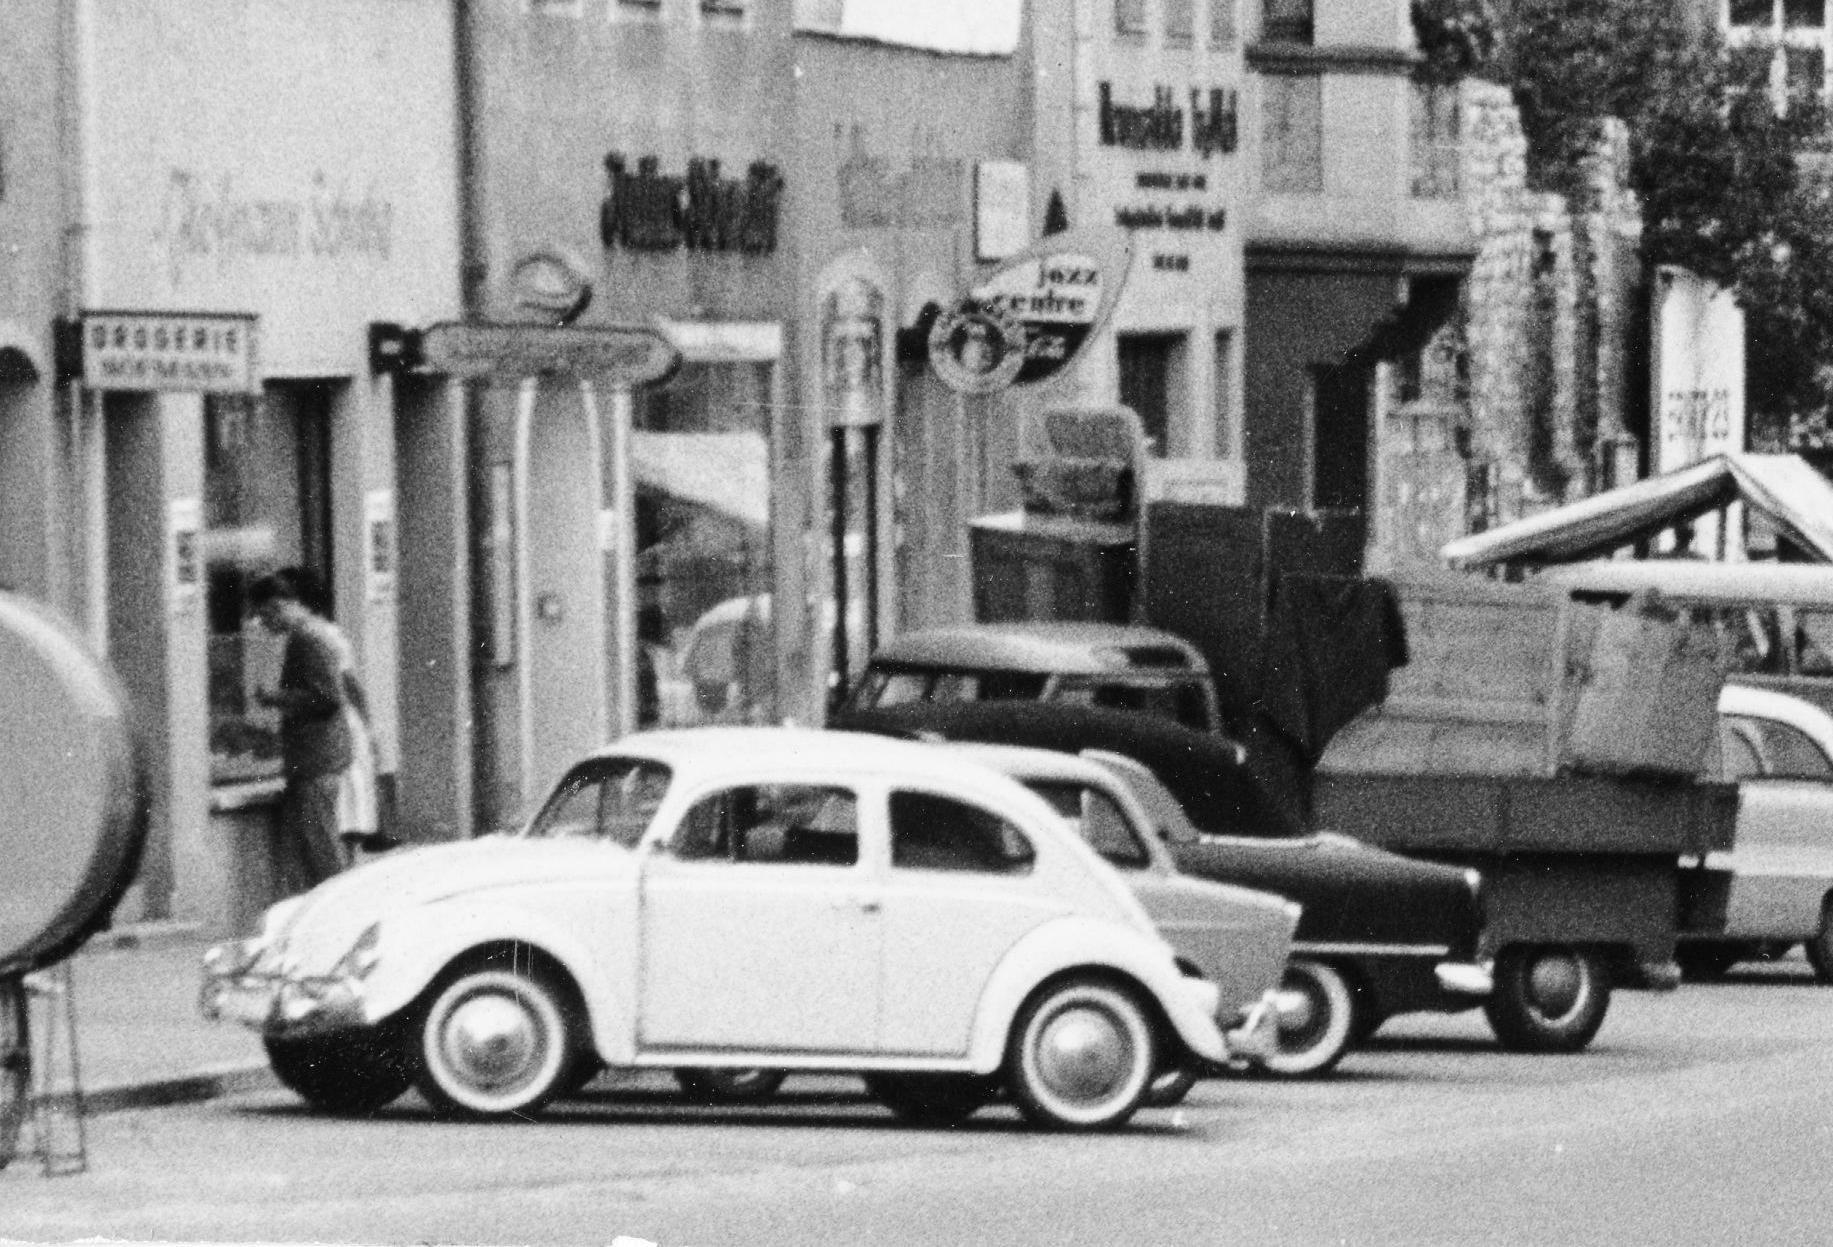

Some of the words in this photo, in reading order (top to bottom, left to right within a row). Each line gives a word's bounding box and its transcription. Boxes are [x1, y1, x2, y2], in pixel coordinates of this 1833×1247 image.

[1037, 263, 1096, 288] jazz
[992, 290, 1085, 318] centre
[91, 324, 238, 352] DROGERIE
